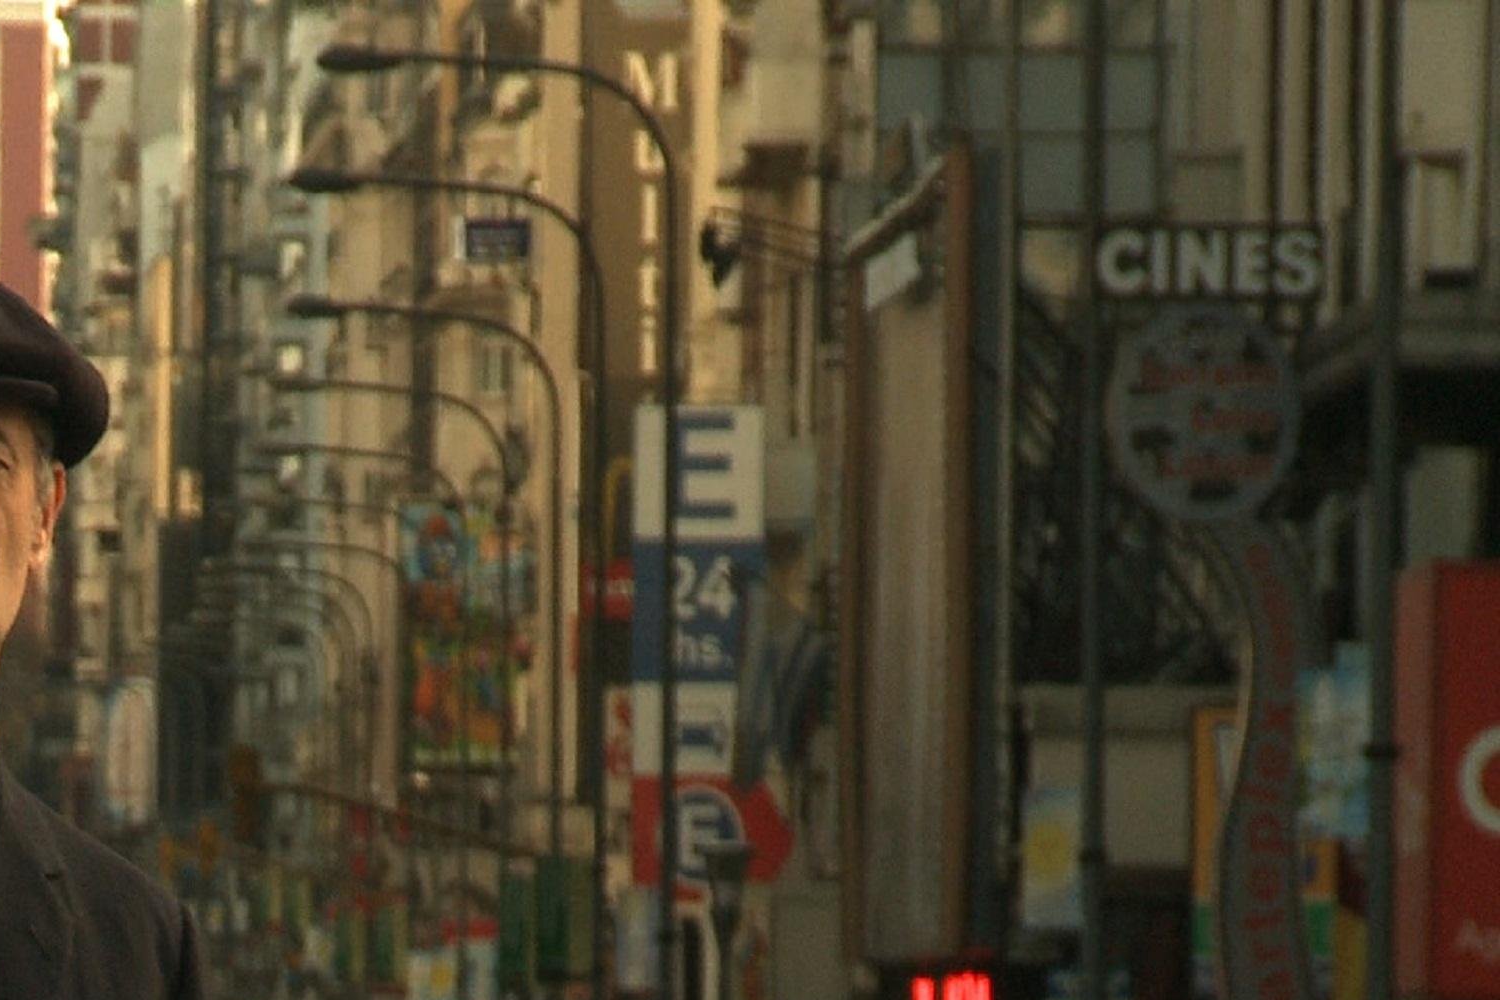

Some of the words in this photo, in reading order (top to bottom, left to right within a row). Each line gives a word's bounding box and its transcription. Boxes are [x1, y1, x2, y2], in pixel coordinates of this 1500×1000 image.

[1098, 227, 1323, 294] CINES
[675, 413, 734, 519] E
[675, 555, 737, 619] 24
